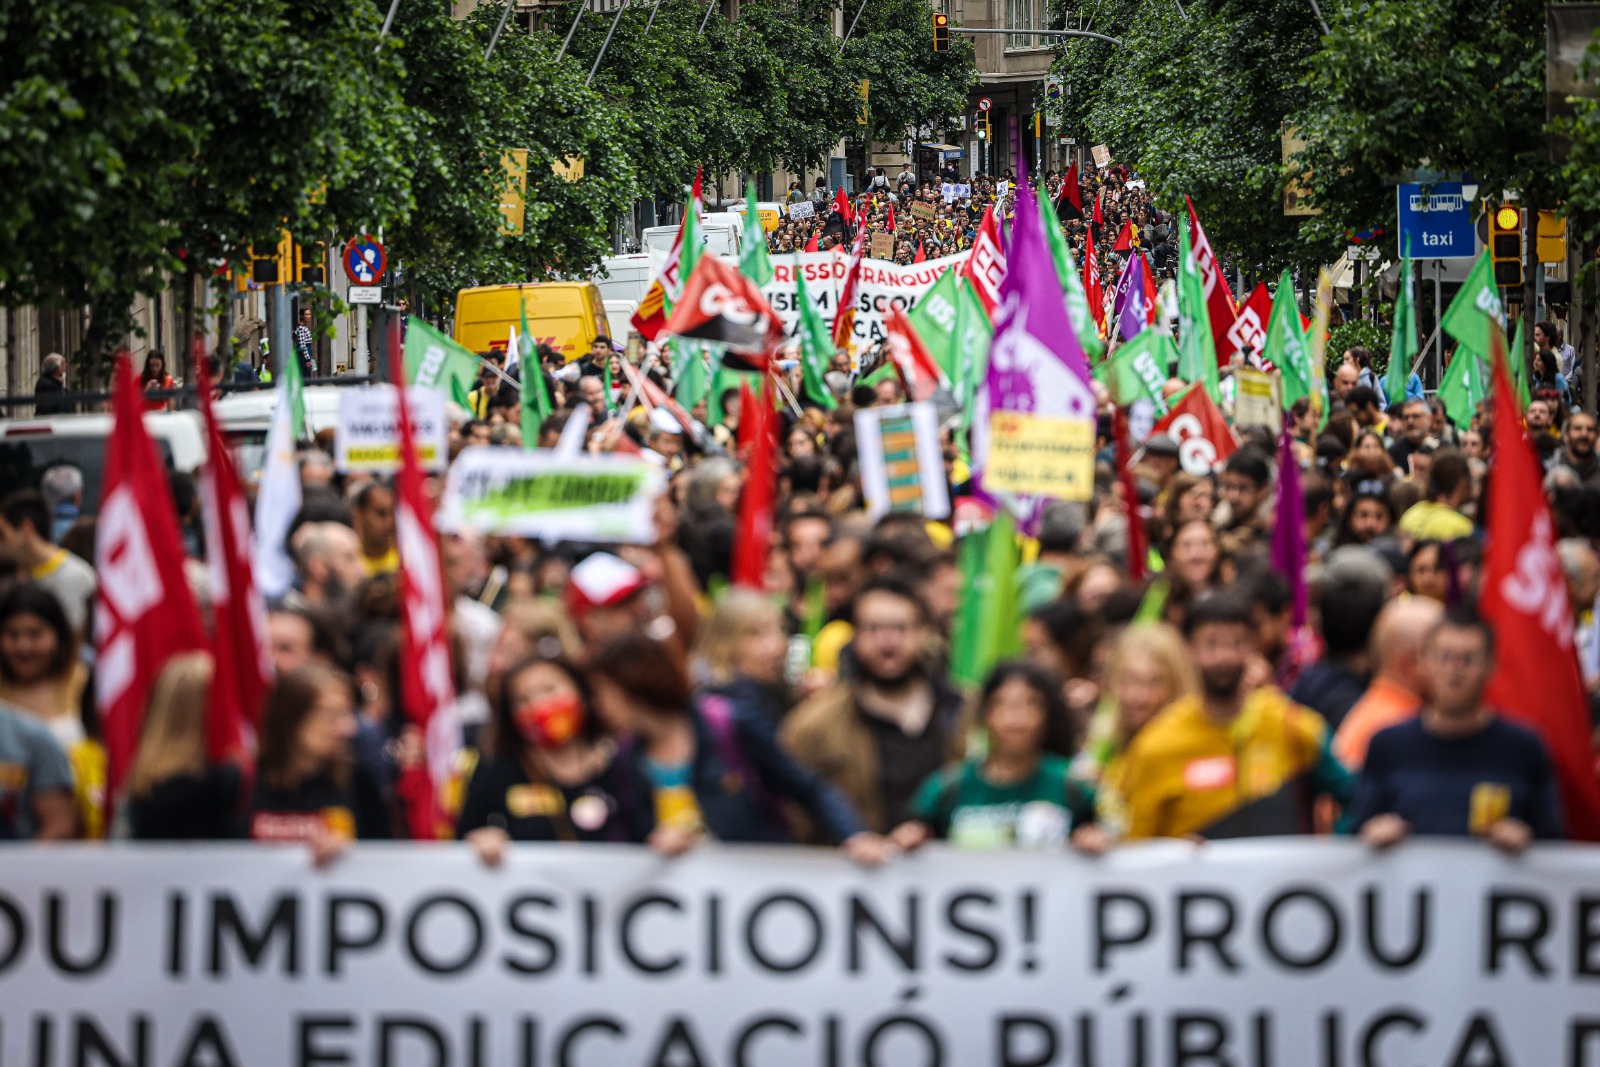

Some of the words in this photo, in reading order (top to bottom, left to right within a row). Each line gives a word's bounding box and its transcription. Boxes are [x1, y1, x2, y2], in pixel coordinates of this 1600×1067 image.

[1422, 231, 1453, 248] taxi
[163, 888, 1038, 982] IMPOSICIONS!
[1092, 885, 1433, 976] PROU
[291, 987, 949, 1067] EDUCACIÓ
[994, 985, 1515, 1067] PÚBLICA
